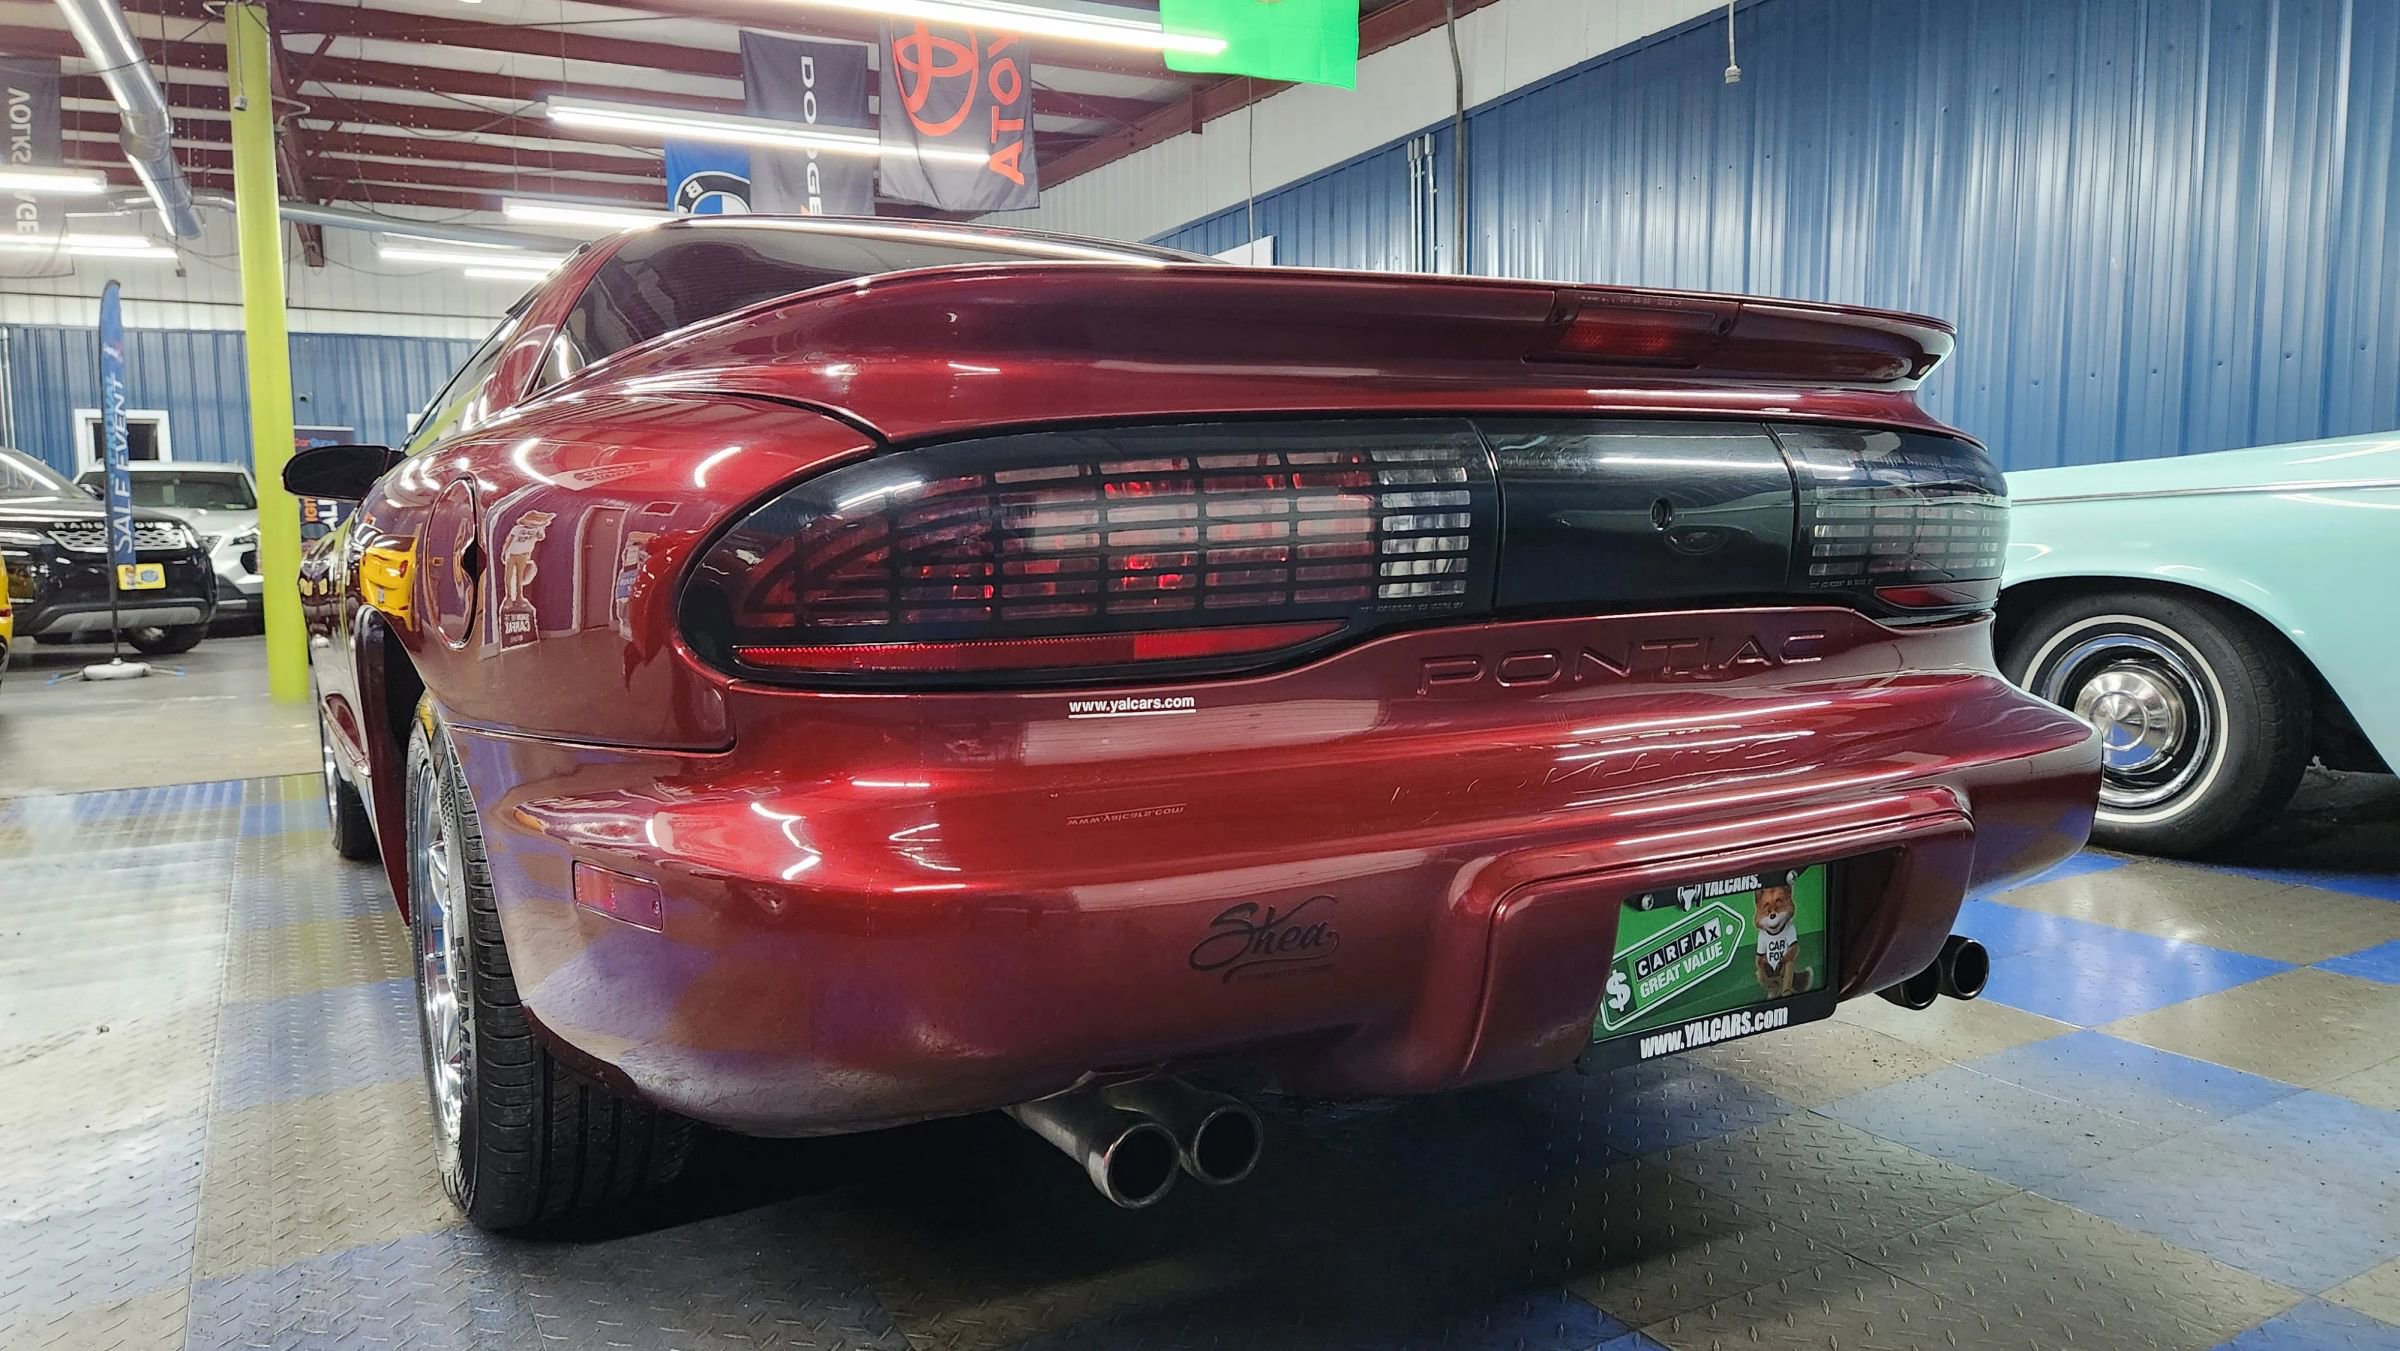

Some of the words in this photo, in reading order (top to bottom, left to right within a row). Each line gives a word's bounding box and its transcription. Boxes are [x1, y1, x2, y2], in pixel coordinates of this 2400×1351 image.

[800, 55, 823, 215] DOGE
[111, 371, 130, 471] EVENT
[54, 521, 104, 530] RANG
[113, 477, 132, 554] SALE
[1416, 630, 1826, 696] PONTIAC
[1068, 696, 1195, 714] www.yalcars.com
[1635, 922, 1721, 978] CARFAX
[1639, 966, 1681, 998] GREAT
[1683, 943, 1724, 973] VALUE
[1768, 939, 1786, 951] CAR
[1768, 950, 1785, 962] FOX
[1640, 1006, 1789, 1059] www.YALCARS.com
